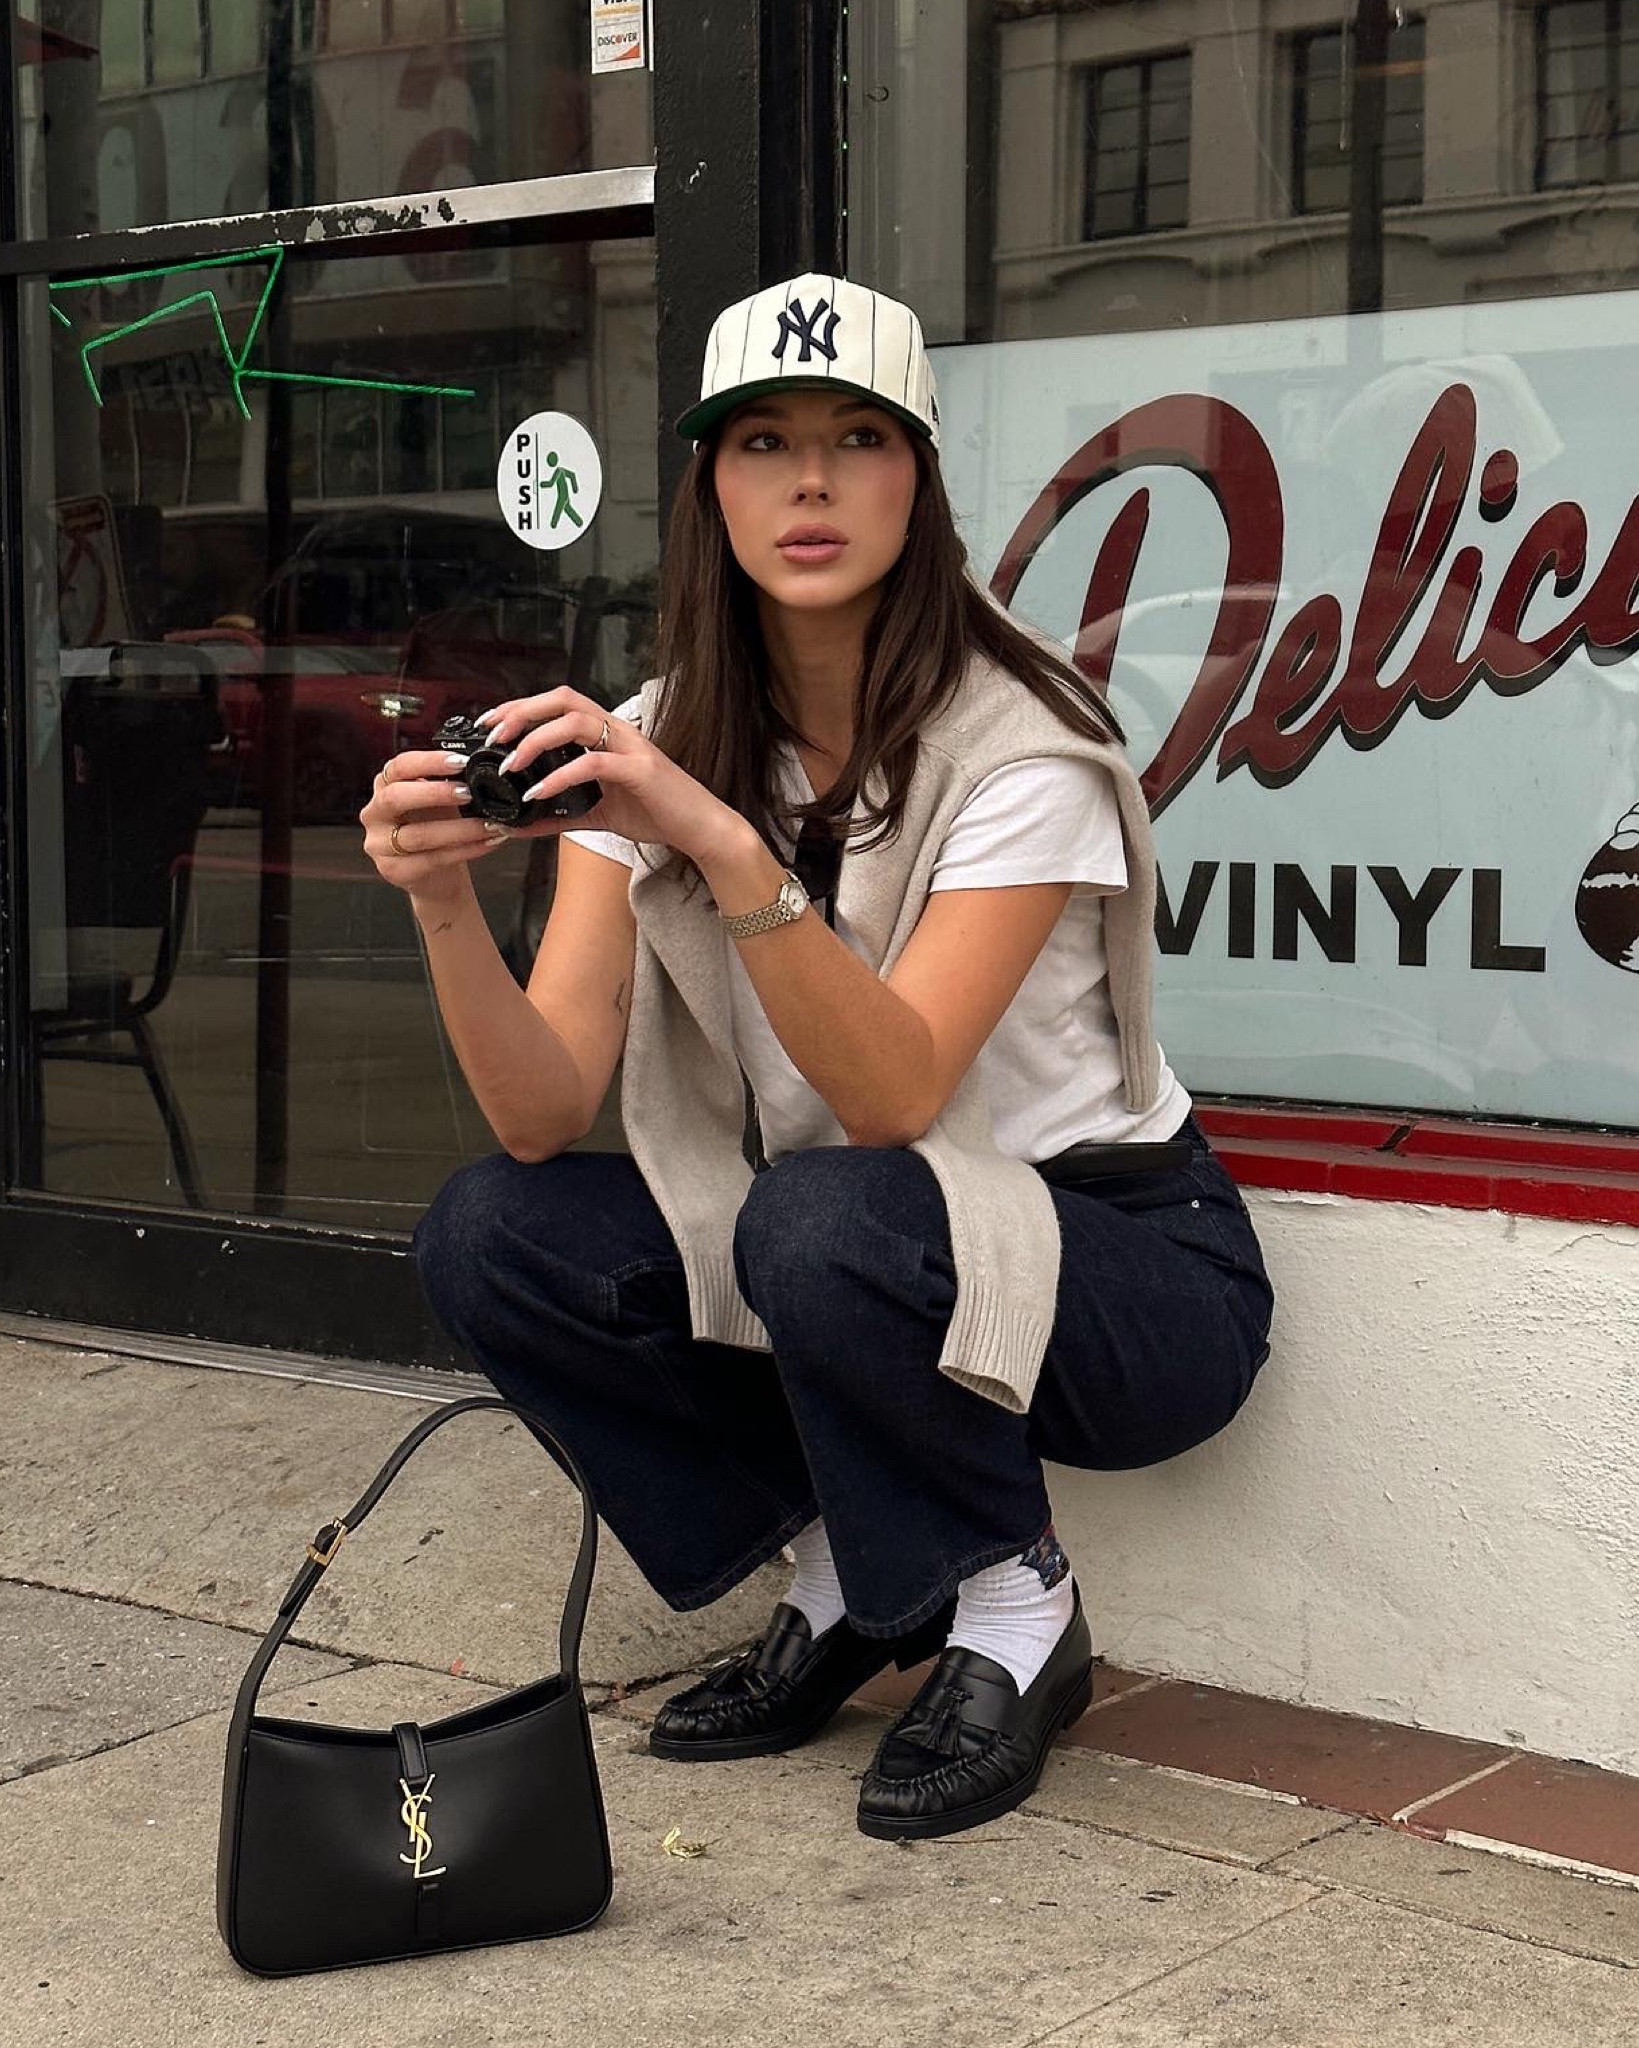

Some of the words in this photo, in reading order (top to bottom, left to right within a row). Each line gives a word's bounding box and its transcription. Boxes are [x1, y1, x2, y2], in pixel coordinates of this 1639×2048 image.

[598, 33, 638, 46] DISCOVER
[772, 297, 841, 362] NY
[516, 433, 533, 531] PUSH
[1154, 860, 1547, 972] VINYL
[398, 1773, 447, 1879] YSL
